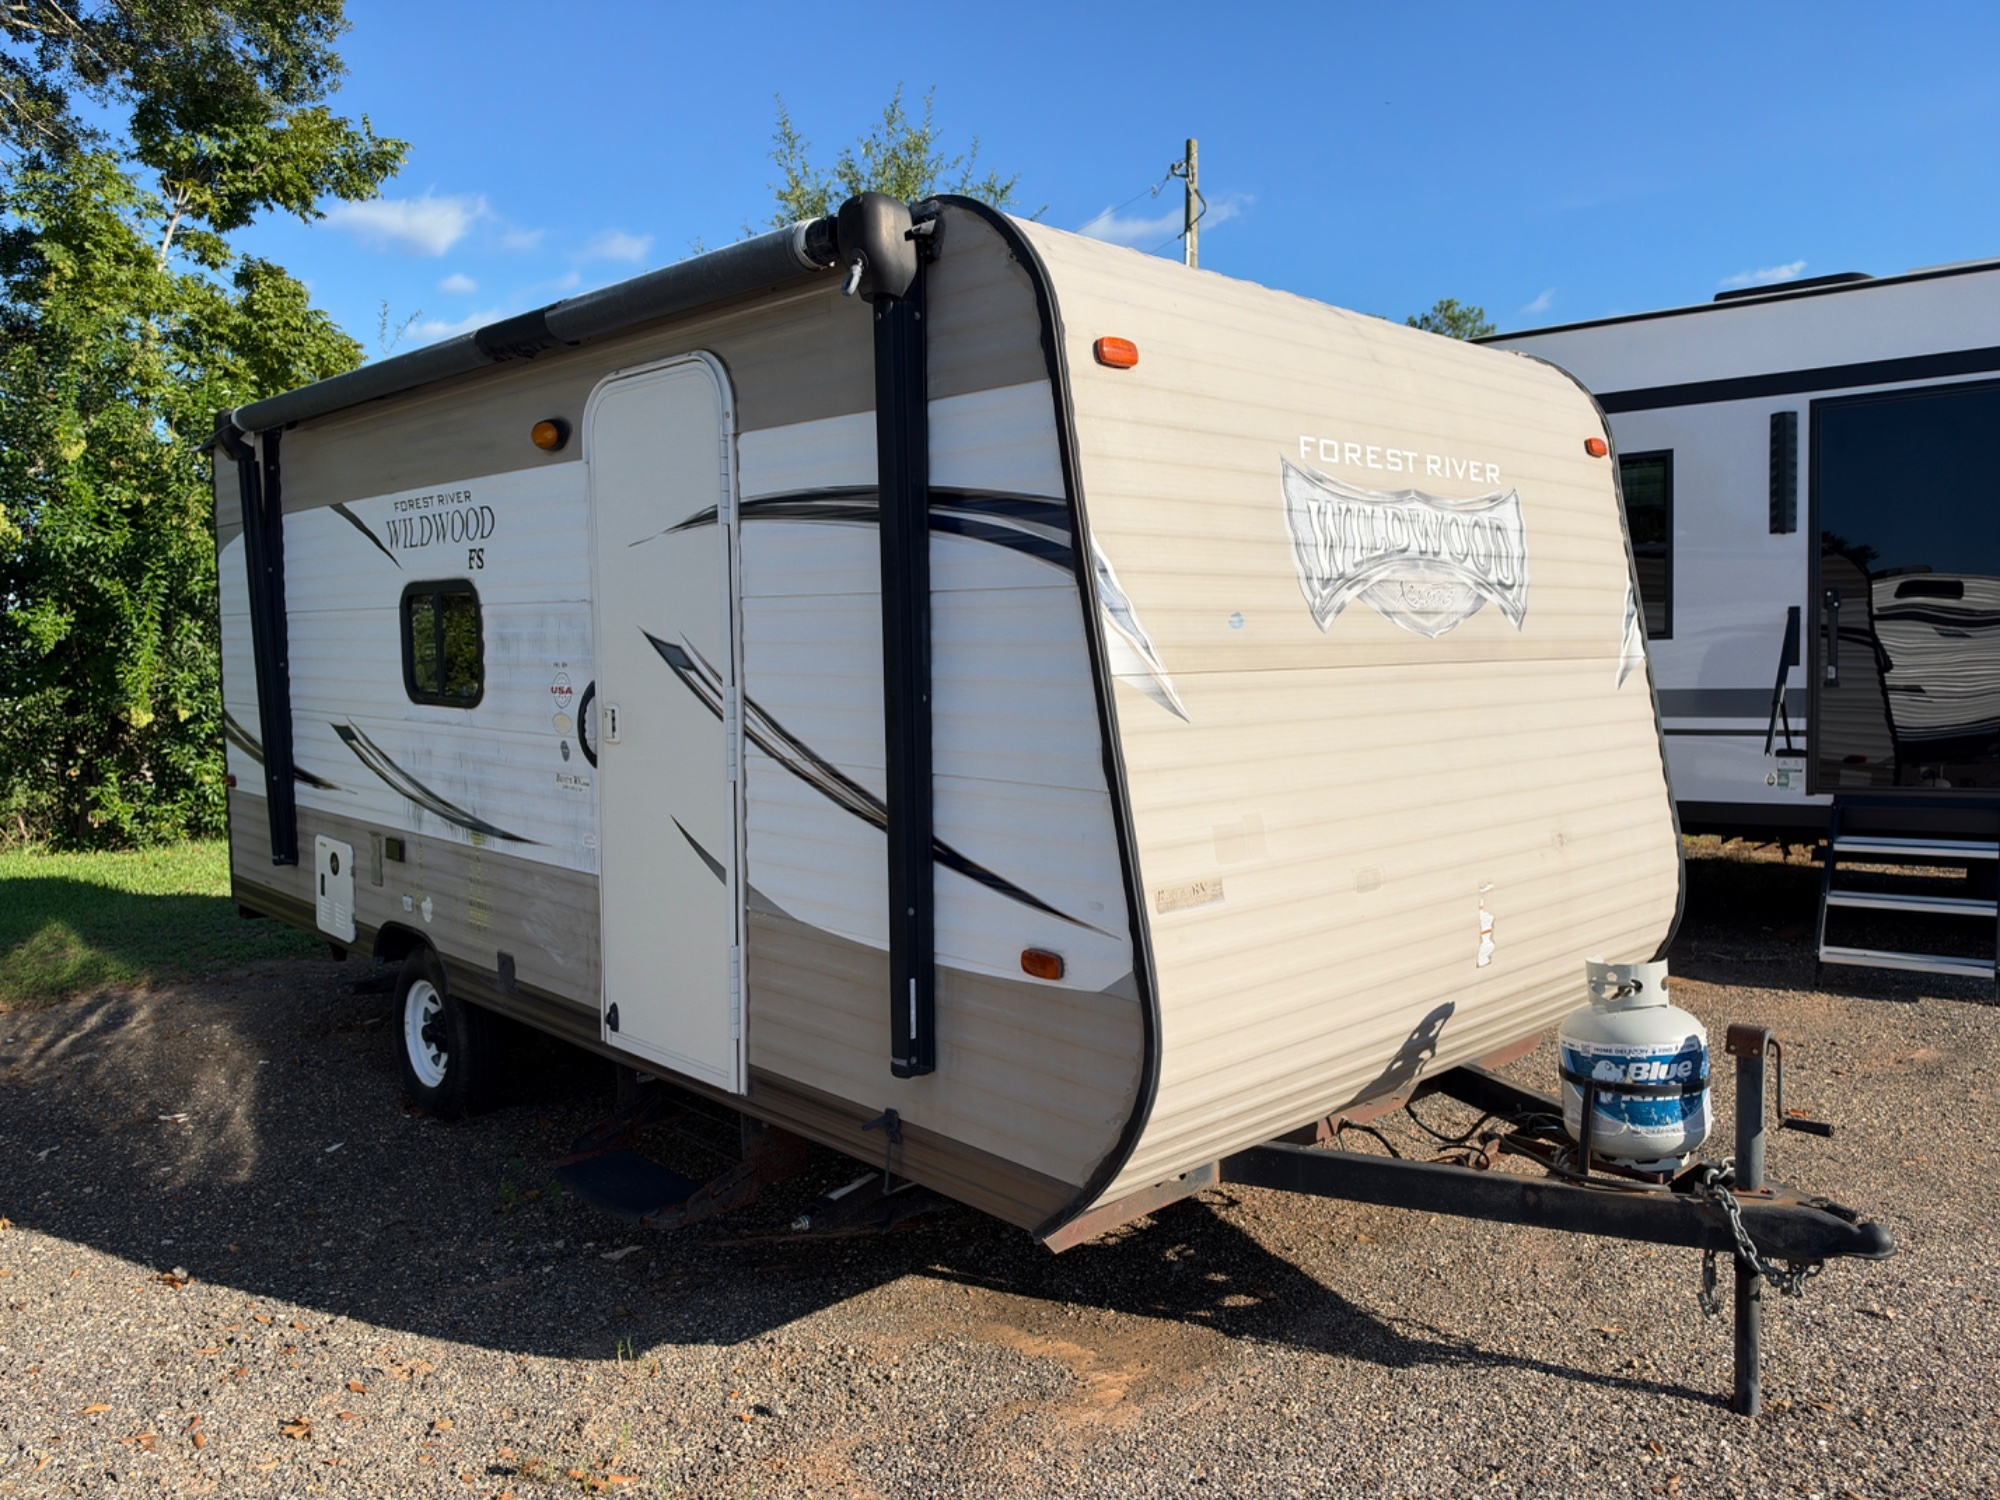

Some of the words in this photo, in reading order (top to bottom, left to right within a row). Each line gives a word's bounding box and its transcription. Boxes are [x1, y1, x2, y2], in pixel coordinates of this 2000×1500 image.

[1299, 435, 1418, 473] FOREST
[1426, 454, 1501, 485] RIVER
[394, 496, 434, 512] FOREST
[437, 490, 471, 506] RIVER
[386, 505, 495, 549] WILDWOOD
[1307, 500, 1515, 589] WILDWOOD
[468, 547, 484, 569] FS
[551, 685, 573, 695] USA
[1629, 1060, 1693, 1079] Blue
